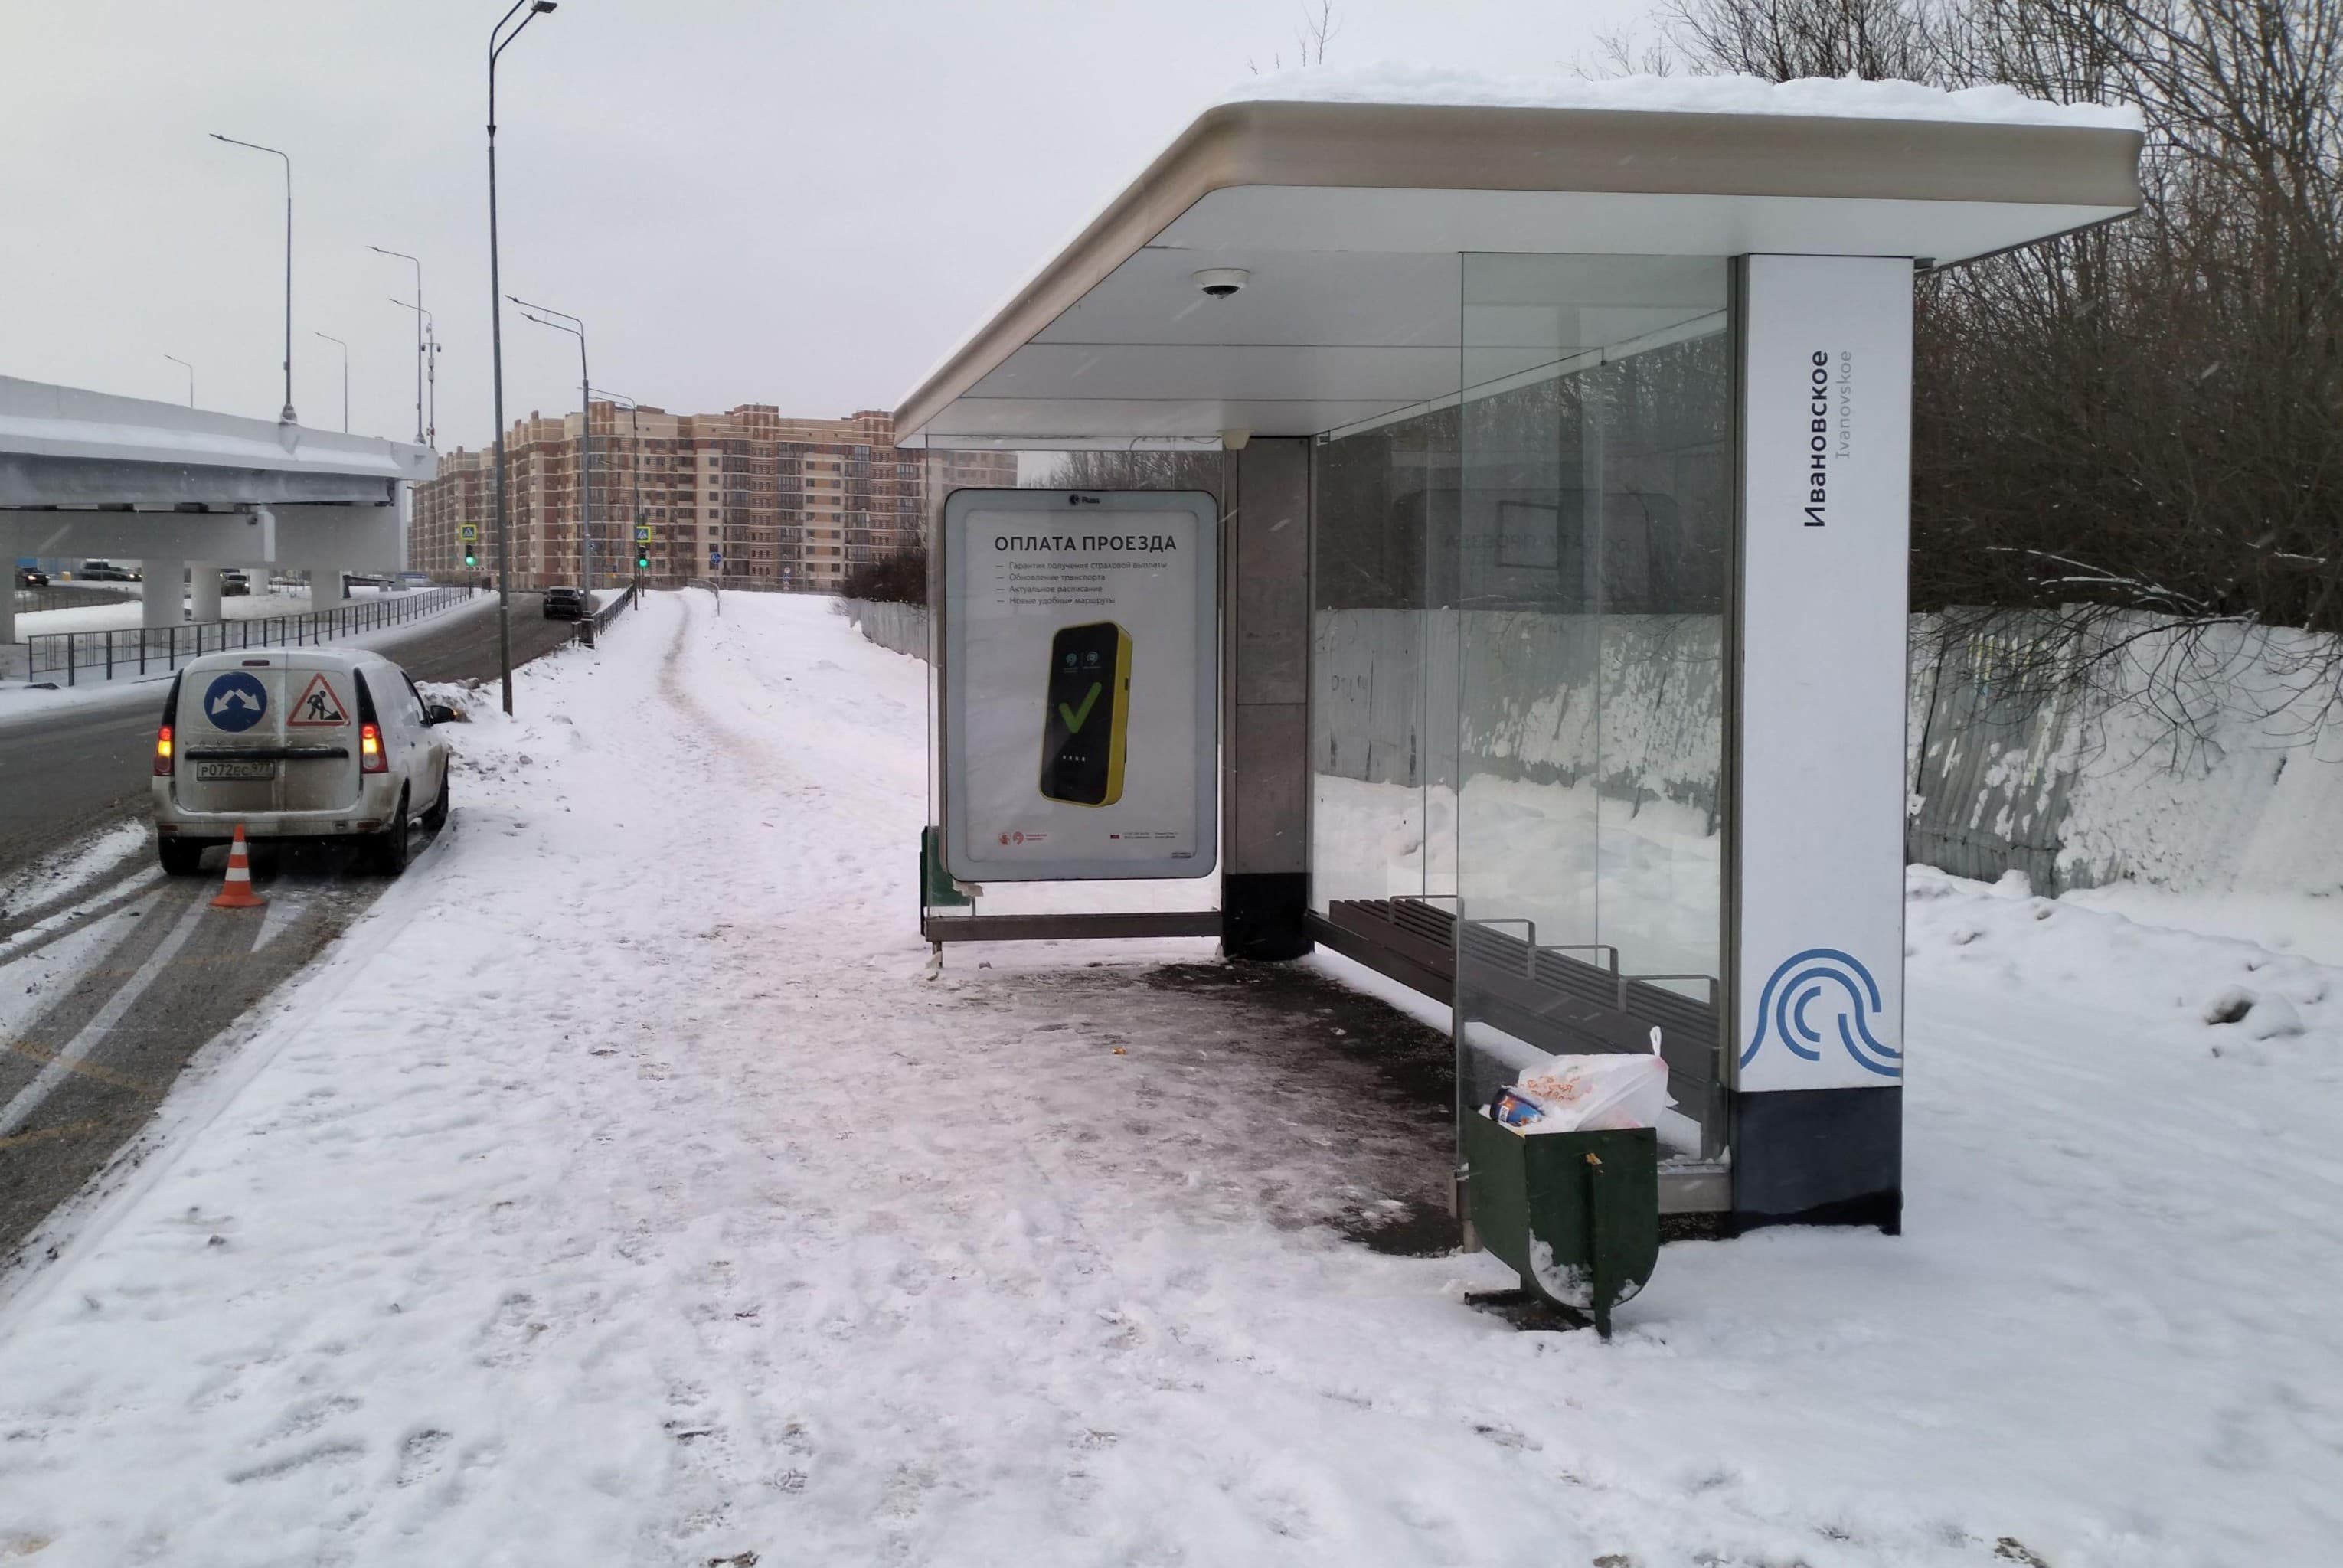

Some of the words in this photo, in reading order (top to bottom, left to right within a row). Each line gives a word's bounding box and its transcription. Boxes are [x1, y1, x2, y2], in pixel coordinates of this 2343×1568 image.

[1836, 350, 1851, 459] Ivanovskoe
[1804, 350, 1828, 527] Ивановское
[995, 536, 1077, 551] ОПЛАТА
[1083, 535, 1177, 553] ПРОЕЗДА
[1008, 562, 1046, 571] Гарантия
[1047, 563, 1089, 571] получения
[1090, 560, 1131, 570] страховой
[1132, 561, 1168, 570] выплаты
[1009, 573, 1059, 582] Обновление
[1061, 574, 1106, 583] транспорта
[1009, 585, 1054, 594] Актуальное
[1057, 586, 1103, 594] расписание
[1038, 597, 1073, 606] удобные
